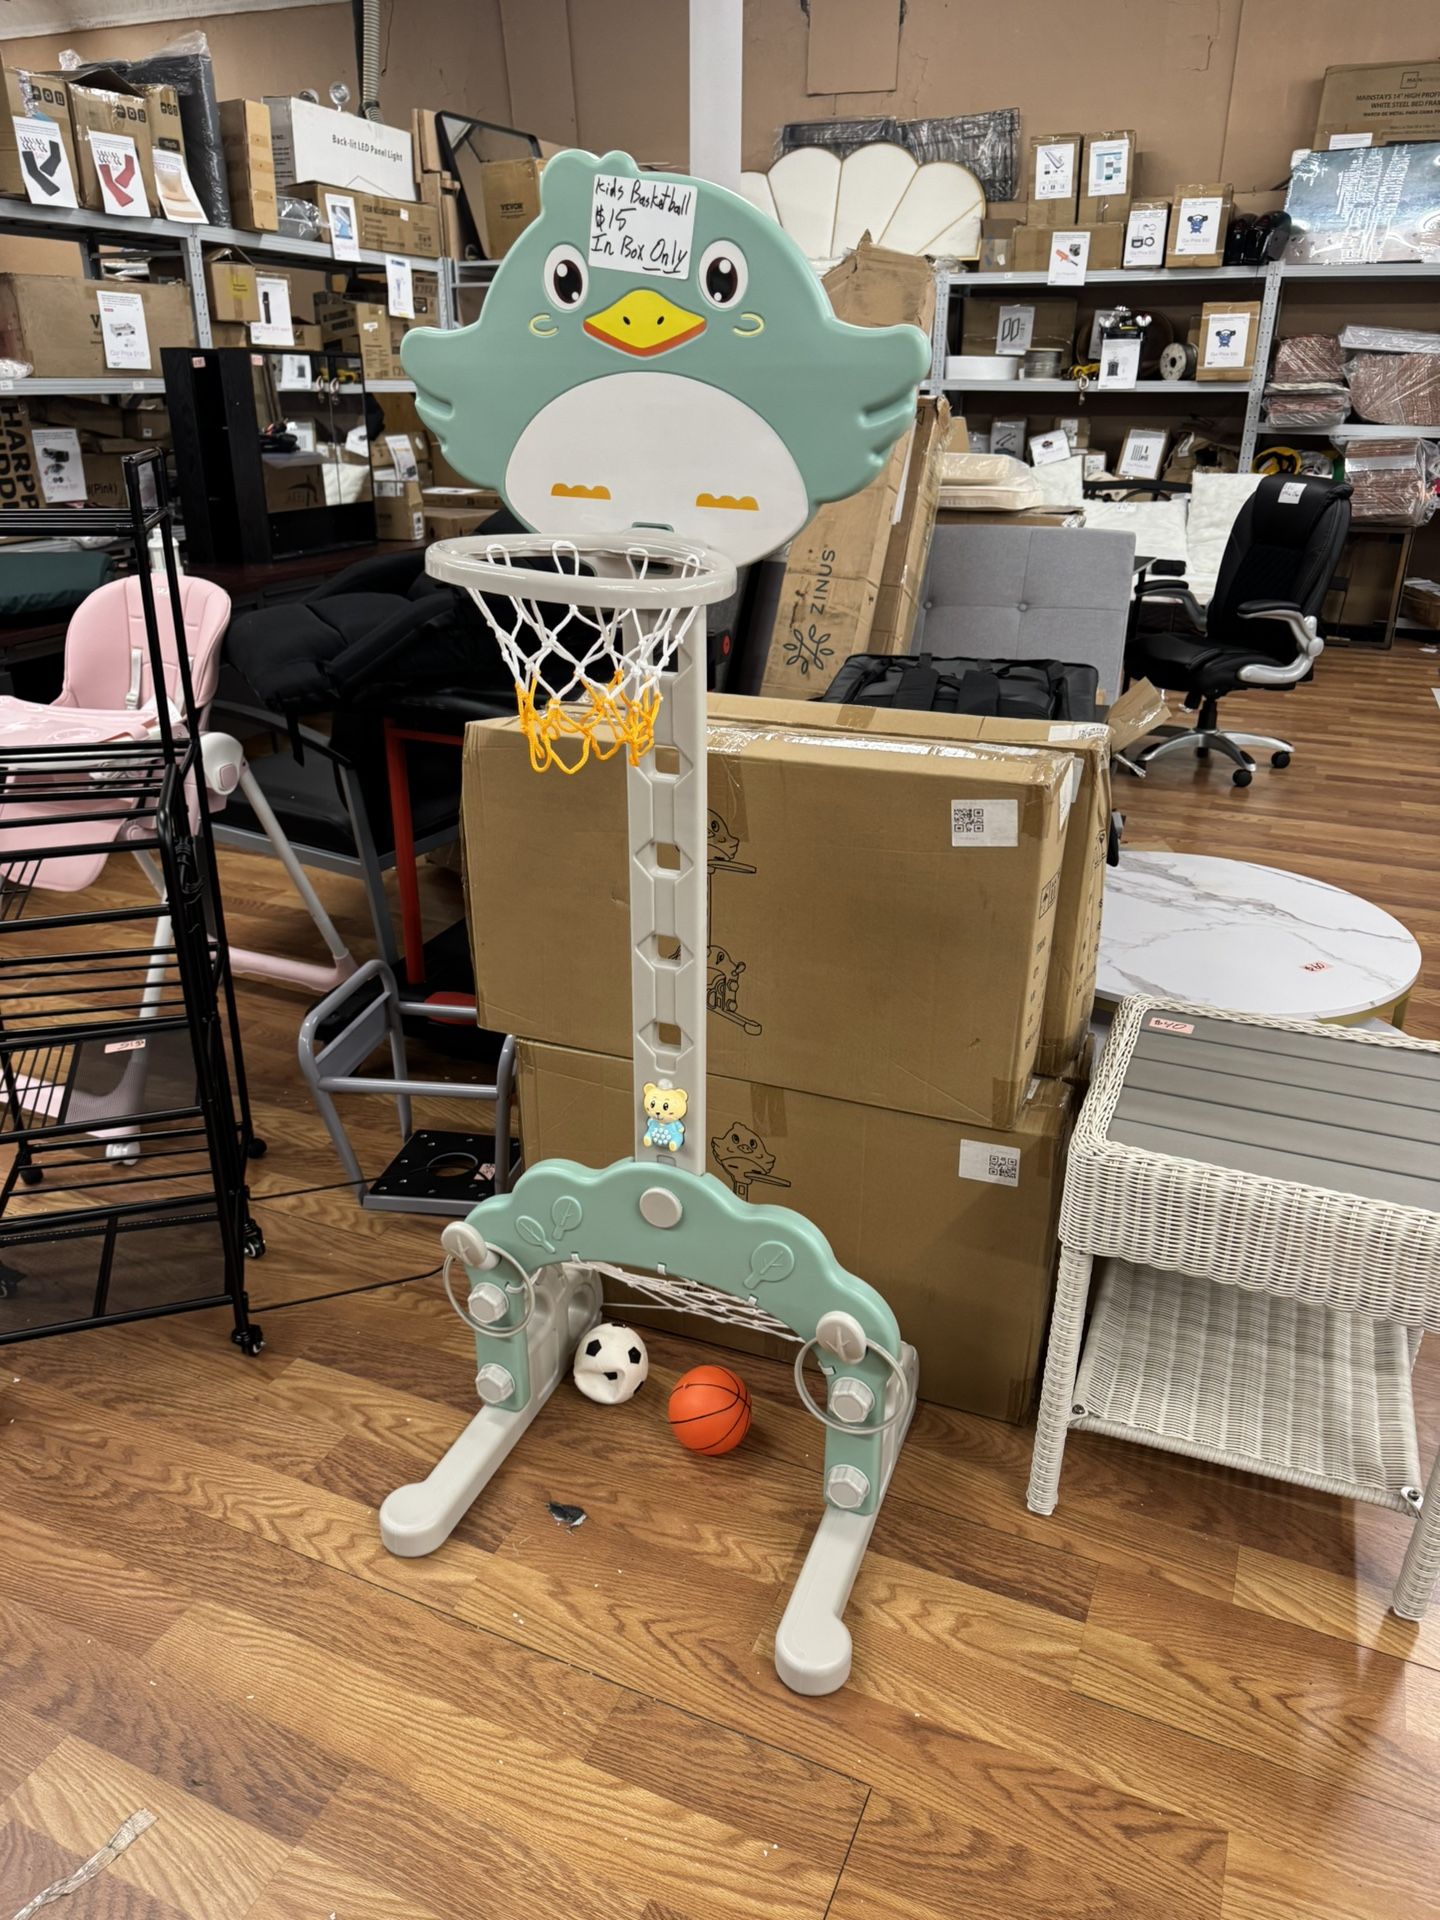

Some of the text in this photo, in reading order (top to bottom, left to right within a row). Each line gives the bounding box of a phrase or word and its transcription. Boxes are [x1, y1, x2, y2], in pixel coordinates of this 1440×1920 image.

[1356, 93, 1392, 101] MAINSTAYS
[332, 134, 403, 162] Back-lit LED Panel Light
[629, 179, 691, 216] Basketball
[595, 204, 637, 232] $15
[591, 233, 688, 273] In Box Only
[810, 549, 836, 615] ZINUS
